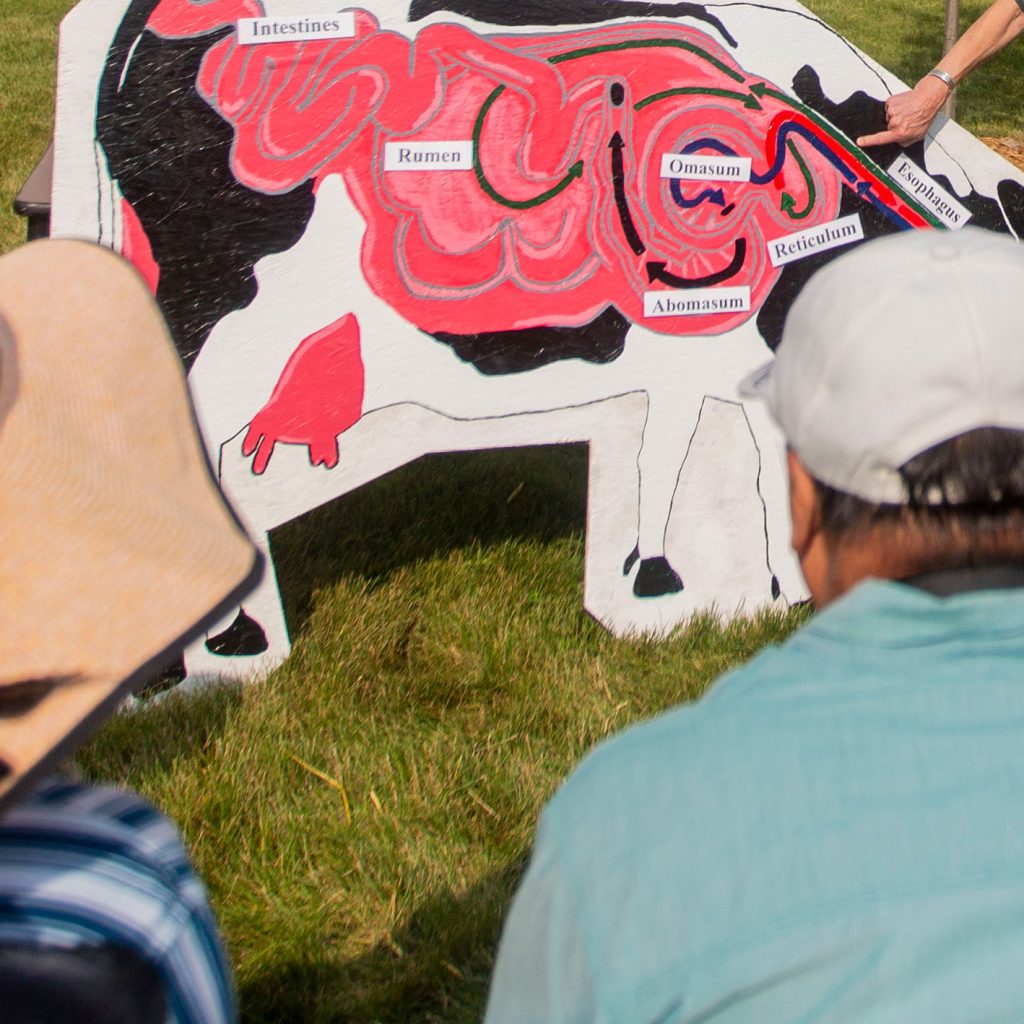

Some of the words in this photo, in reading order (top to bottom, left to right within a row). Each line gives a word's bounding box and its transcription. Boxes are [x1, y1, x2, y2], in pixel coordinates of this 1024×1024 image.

[253, 18, 340, 36] Intestines
[398, 148, 461, 163] Rumen
[669, 159, 741, 177] Omasum
[897, 161, 961, 223] Esophagus
[774, 223, 857, 259] Reticulum
[652, 297, 744, 314] Abomasum
